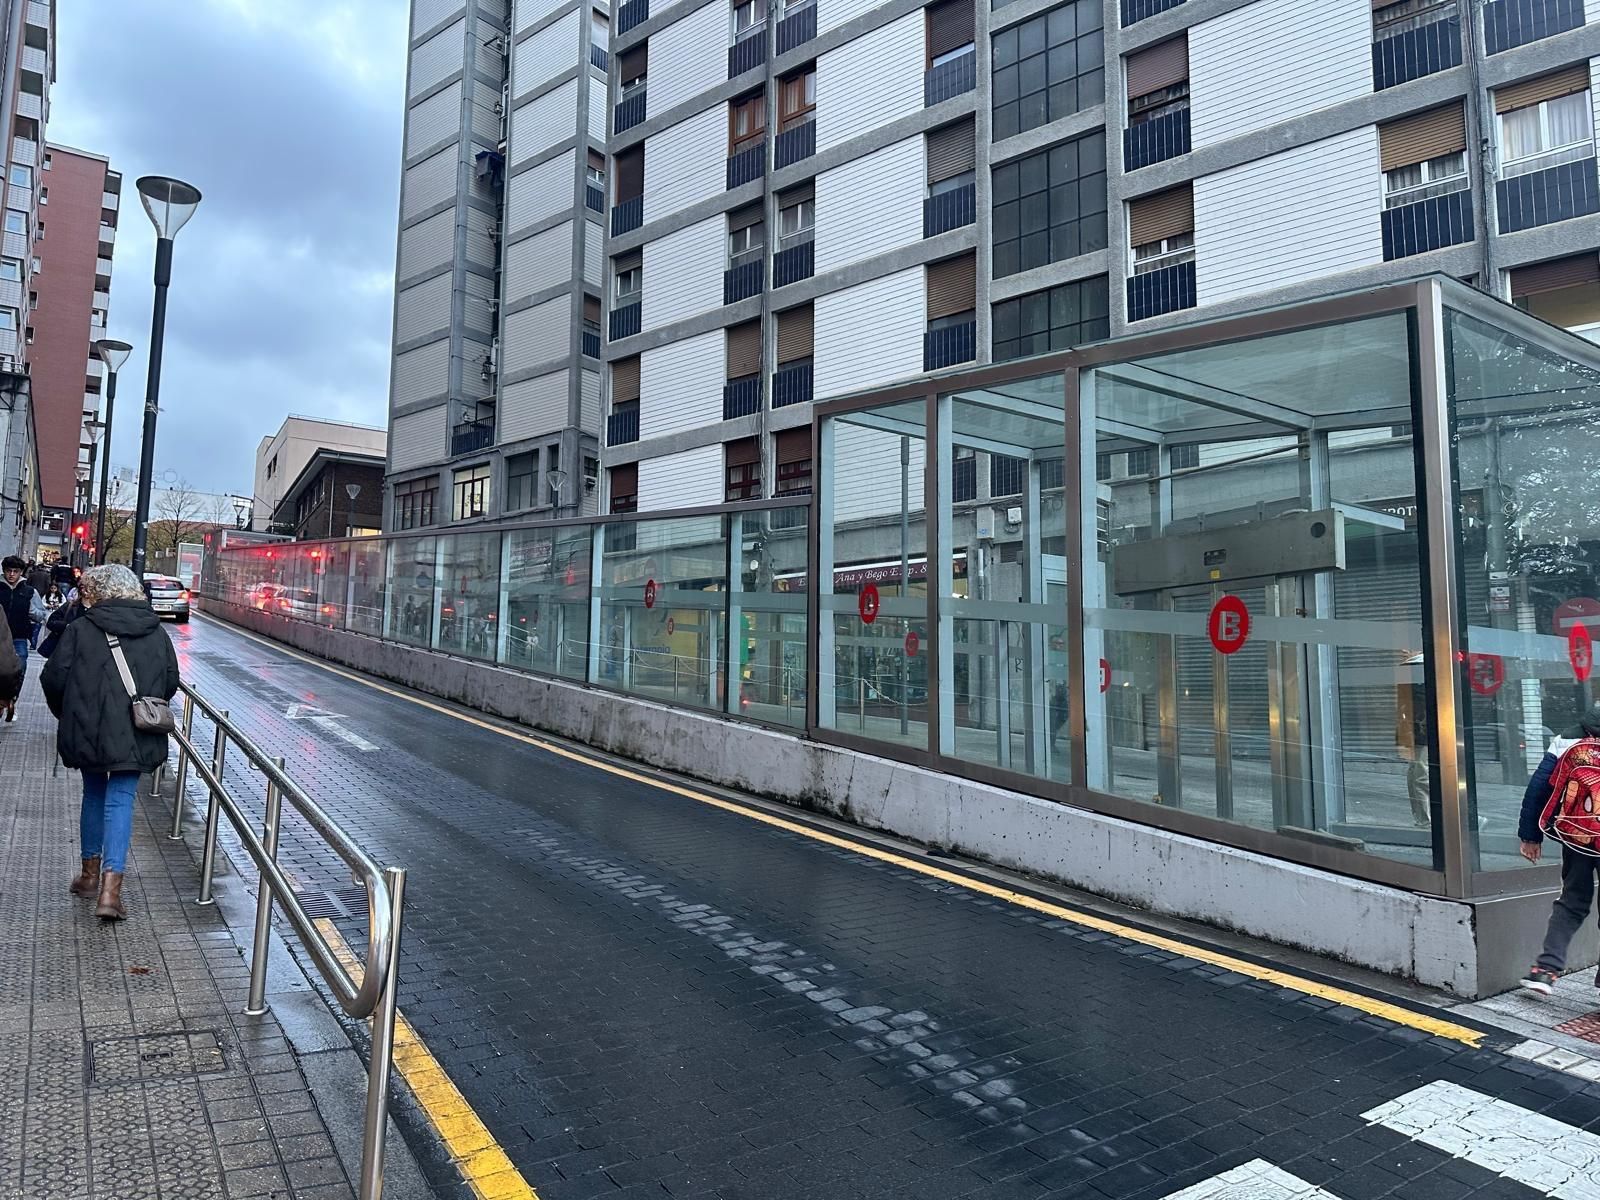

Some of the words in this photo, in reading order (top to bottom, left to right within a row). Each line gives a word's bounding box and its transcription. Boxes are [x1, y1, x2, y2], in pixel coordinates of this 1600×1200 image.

[835, 573, 855, 583] Ana
[856, 573, 864, 583] y
[865, 570, 888, 582] Bego
[1218, 611, 1241, 641] B
